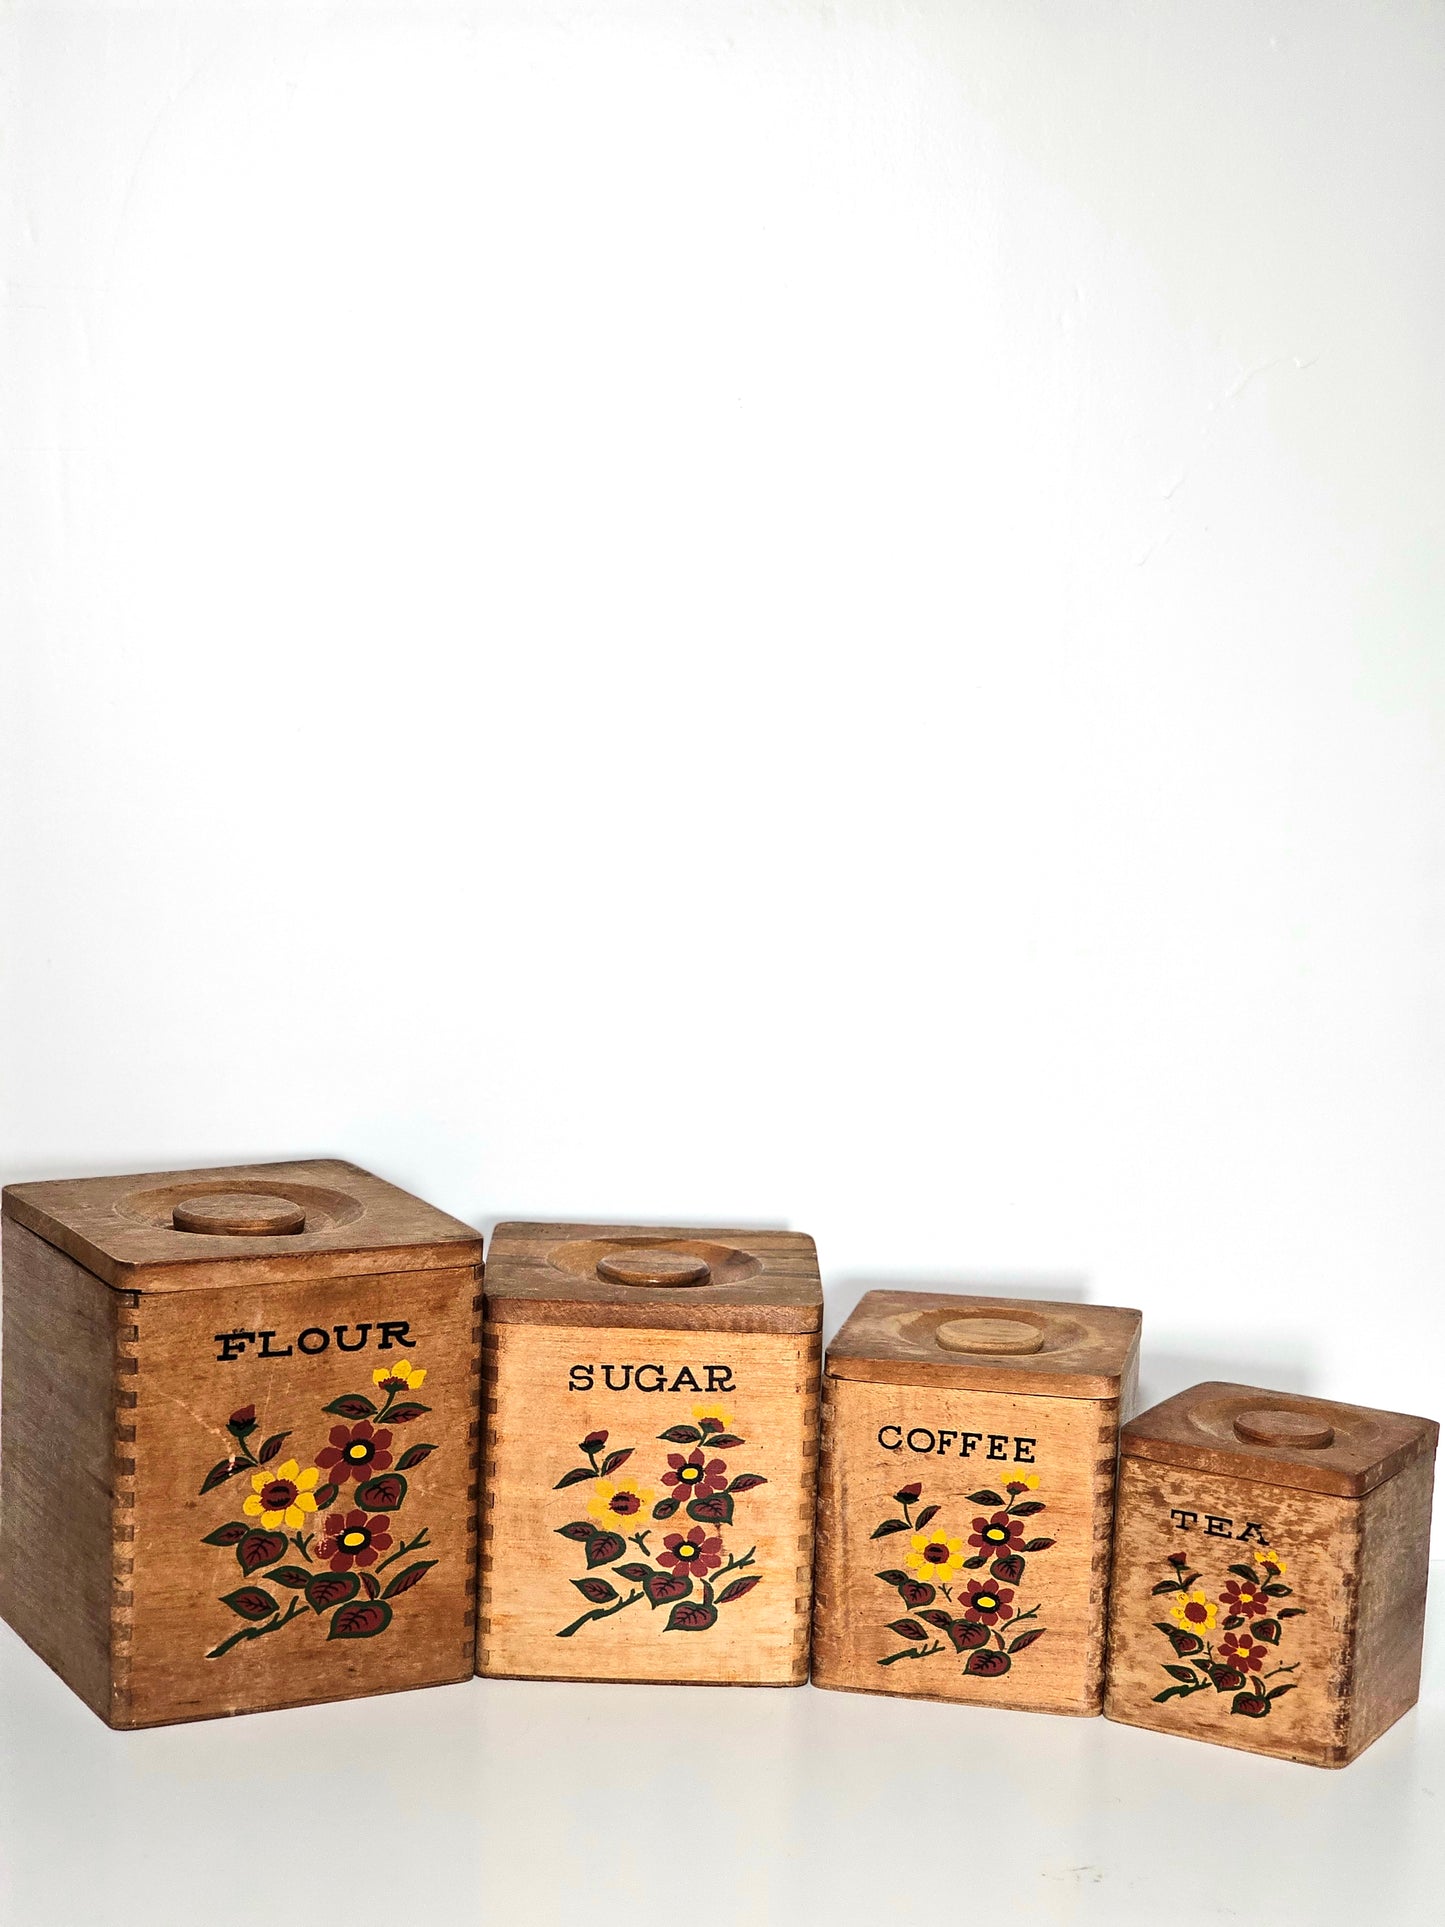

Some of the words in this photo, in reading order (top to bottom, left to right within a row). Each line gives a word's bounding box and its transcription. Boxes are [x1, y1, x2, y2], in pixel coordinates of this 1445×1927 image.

[214, 1320, 417, 1362] FLOUR
[568, 1364, 737, 1393] SUGAR
[877, 1425, 1037, 1464] COFFEE
[1170, 1508, 1270, 1546] TEA
